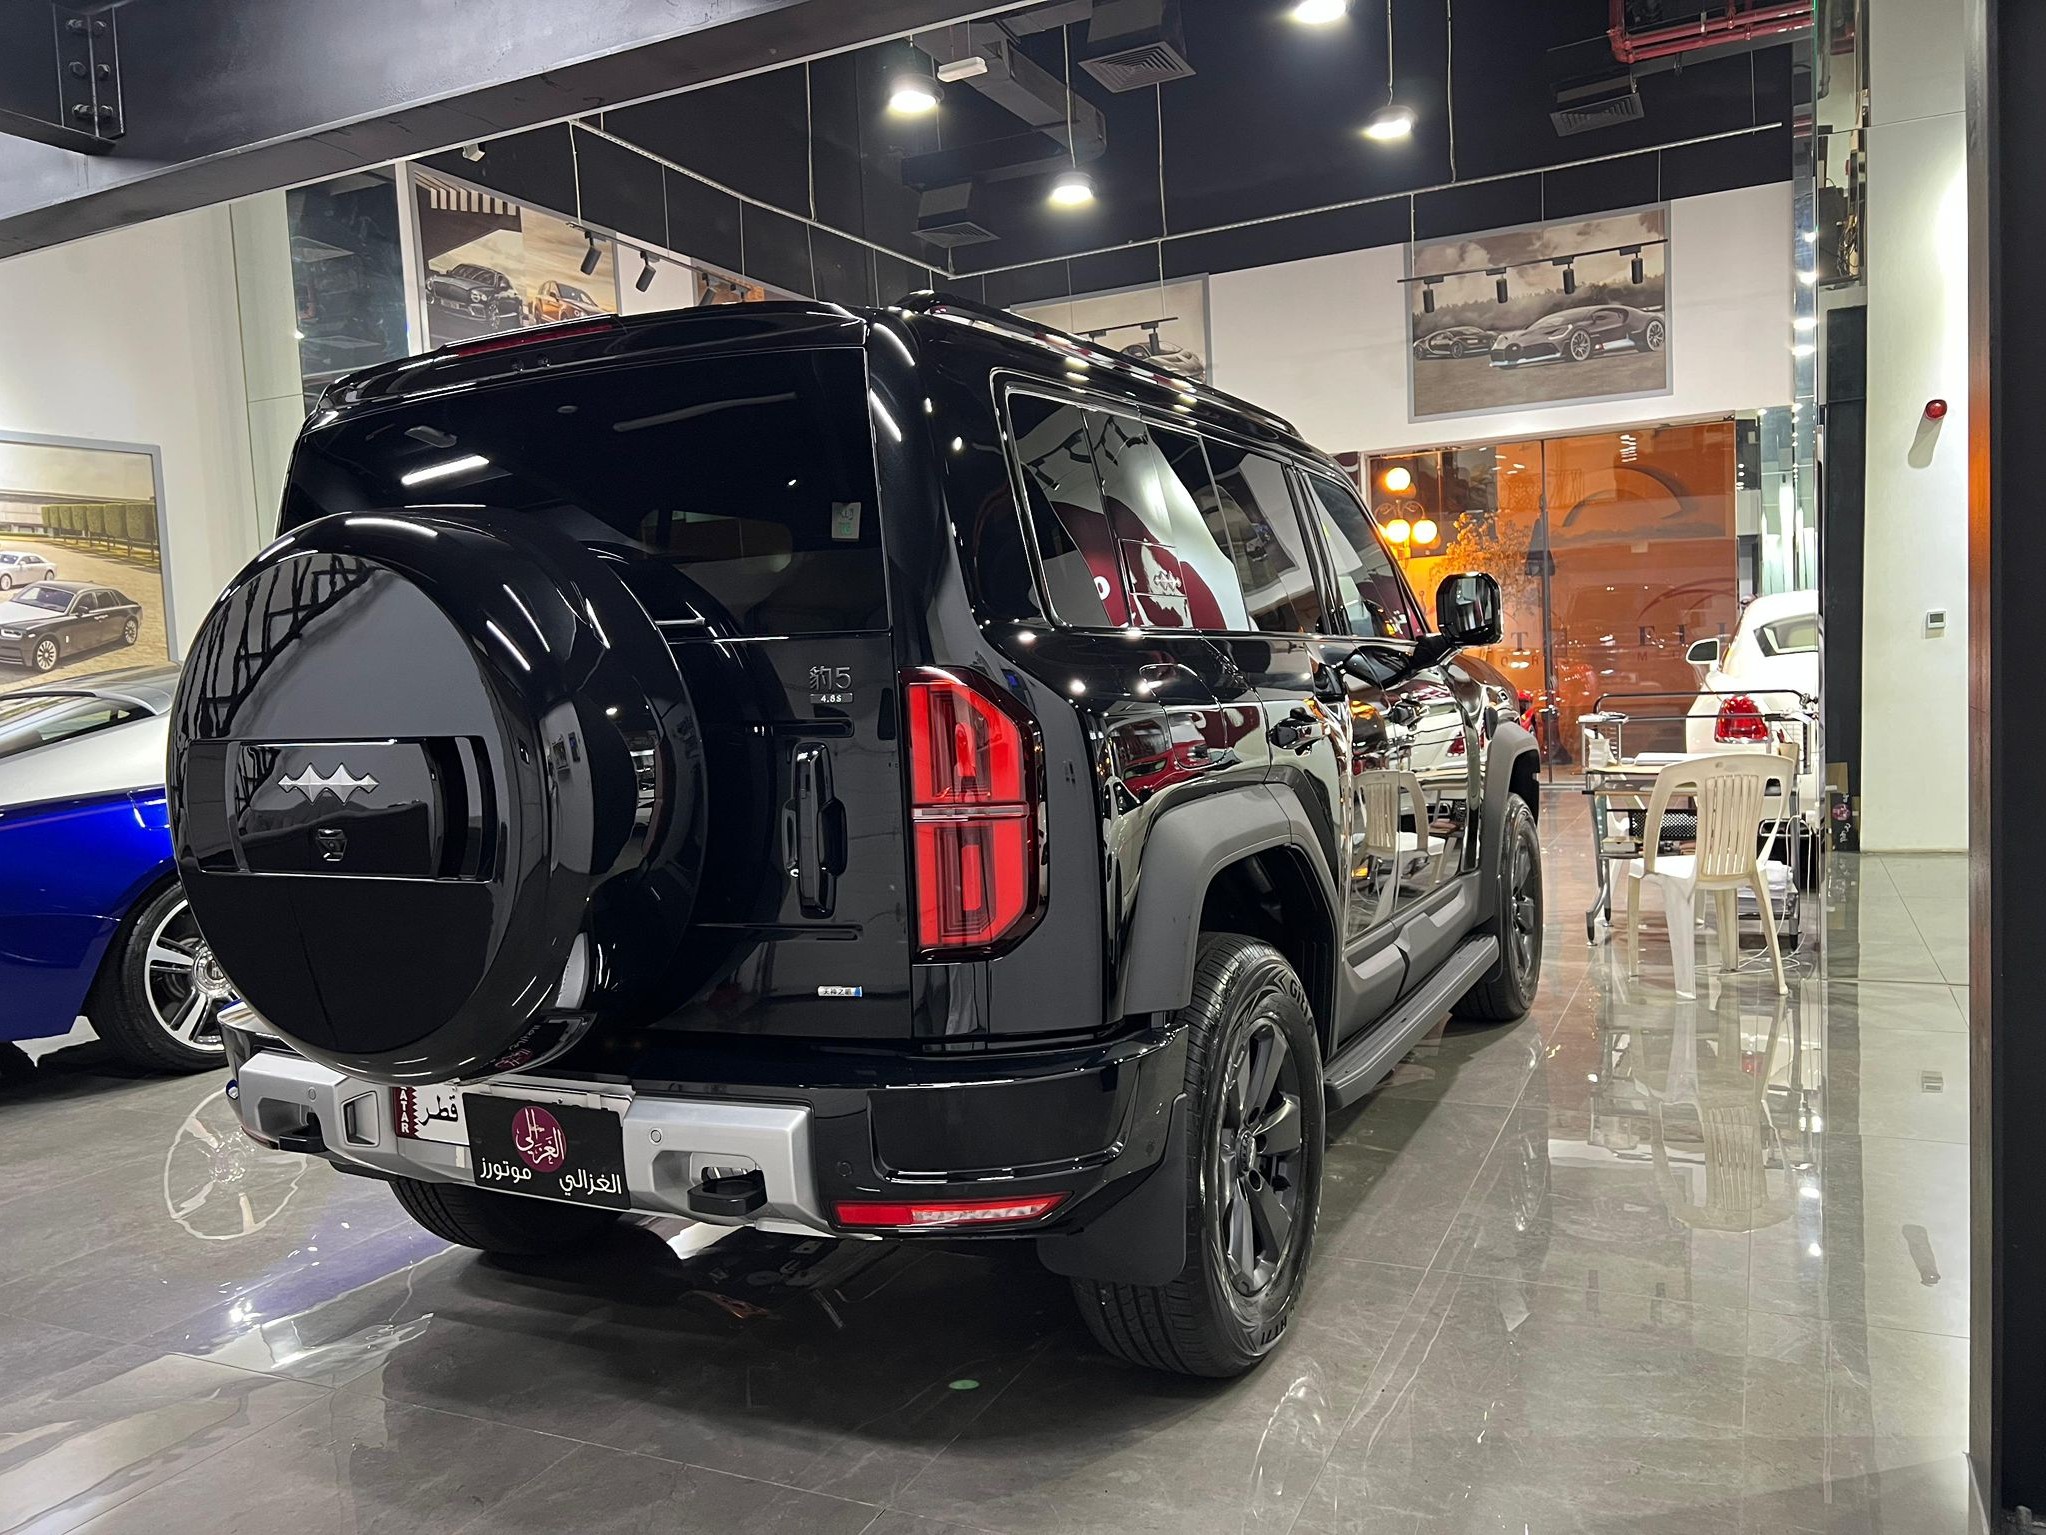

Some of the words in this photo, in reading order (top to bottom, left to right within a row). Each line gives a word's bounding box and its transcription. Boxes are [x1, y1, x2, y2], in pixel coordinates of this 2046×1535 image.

[417, 1094, 459, 1127] قطر
[480, 1156, 532, 1184] موتورز
[559, 1168, 622, 1197] الغزالي
